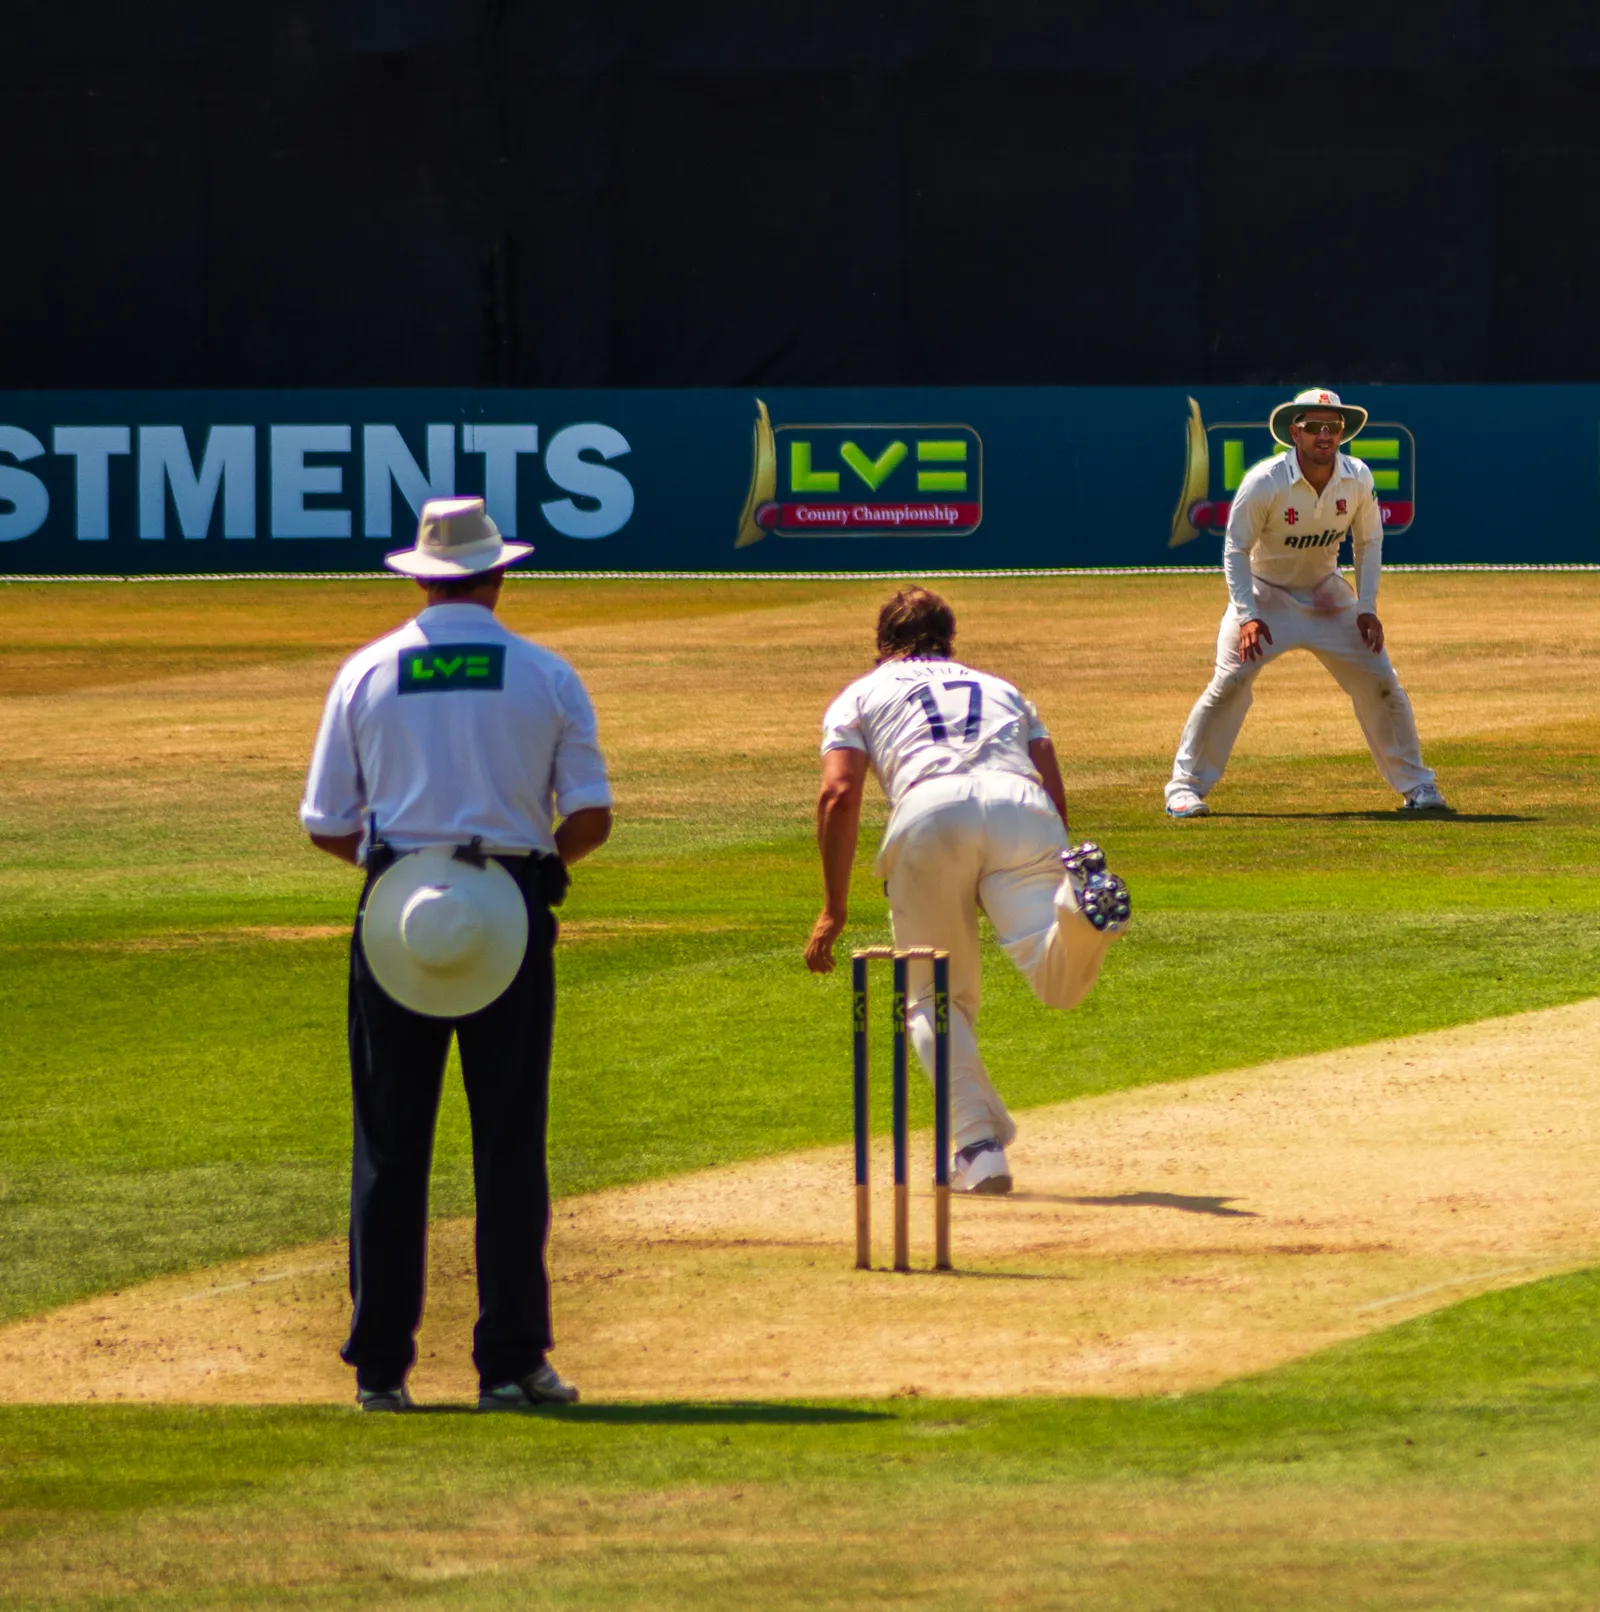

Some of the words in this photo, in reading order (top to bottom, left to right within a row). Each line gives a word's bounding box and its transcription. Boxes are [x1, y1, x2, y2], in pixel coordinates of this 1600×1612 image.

[796, 505, 849, 525] County
[853, 505, 959, 525] Championship
[908, 680, 982, 743] 17
